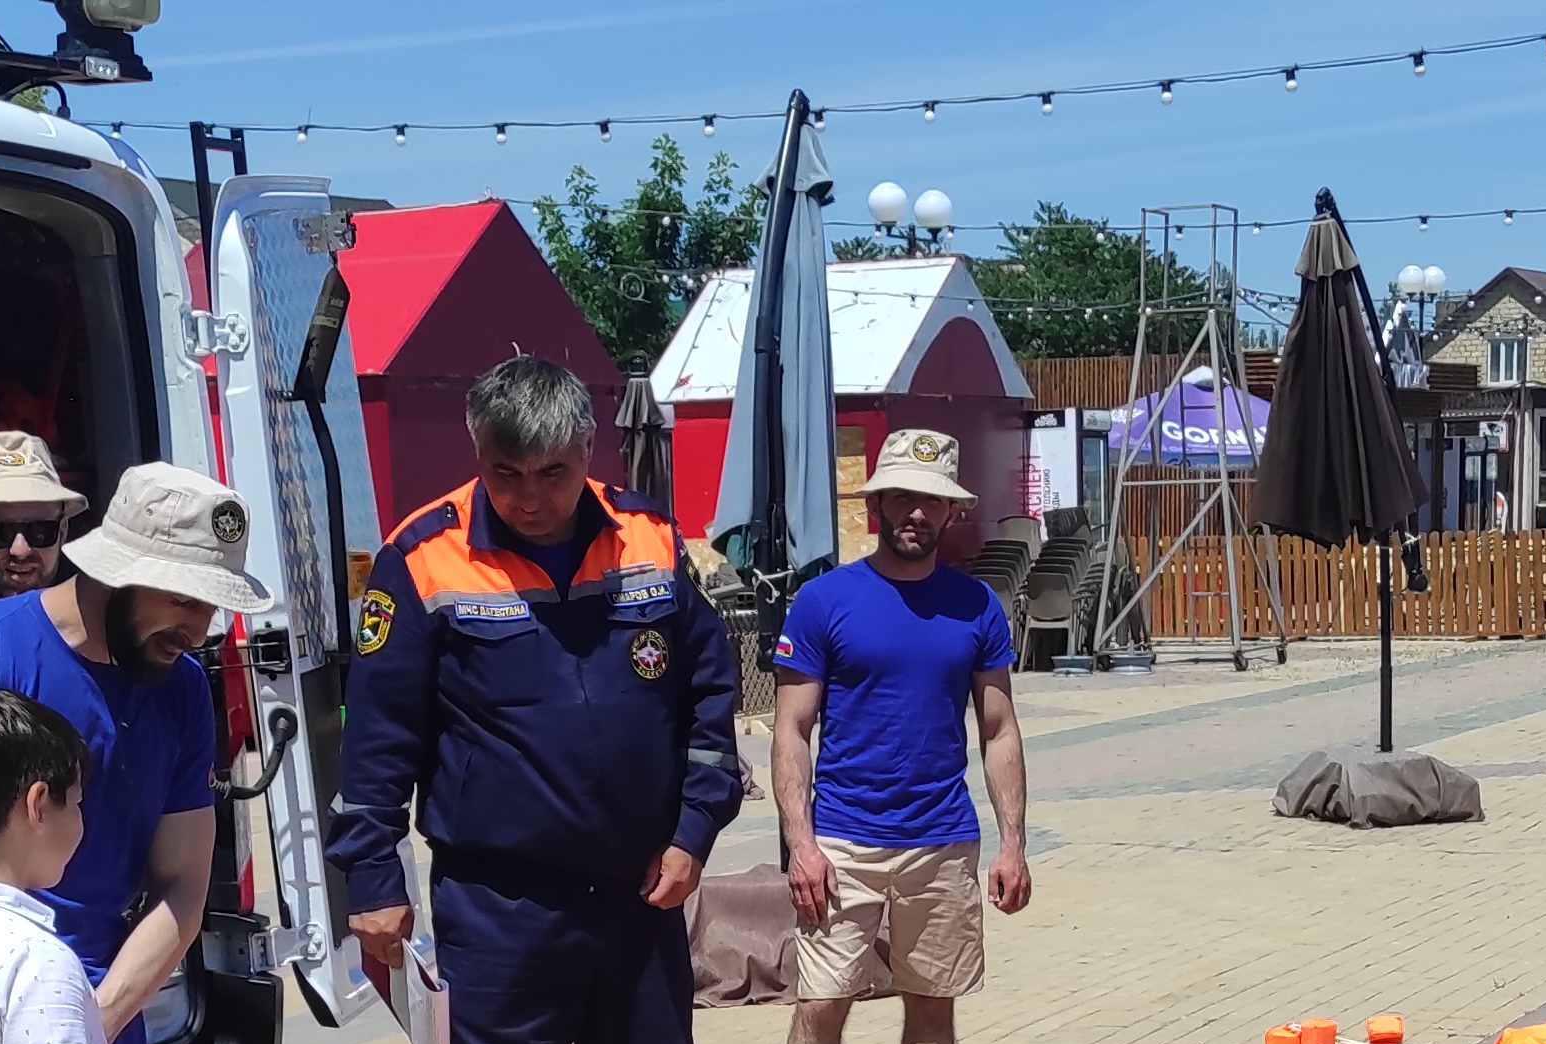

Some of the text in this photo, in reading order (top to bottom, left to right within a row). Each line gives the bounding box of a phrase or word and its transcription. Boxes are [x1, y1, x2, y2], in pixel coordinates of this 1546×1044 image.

[1018, 454, 1041, 517] КСПЕРТ
[1043, 468, 1051, 510] ТОЛЕНИЮ
[457, 604, 479, 615] МЧС
